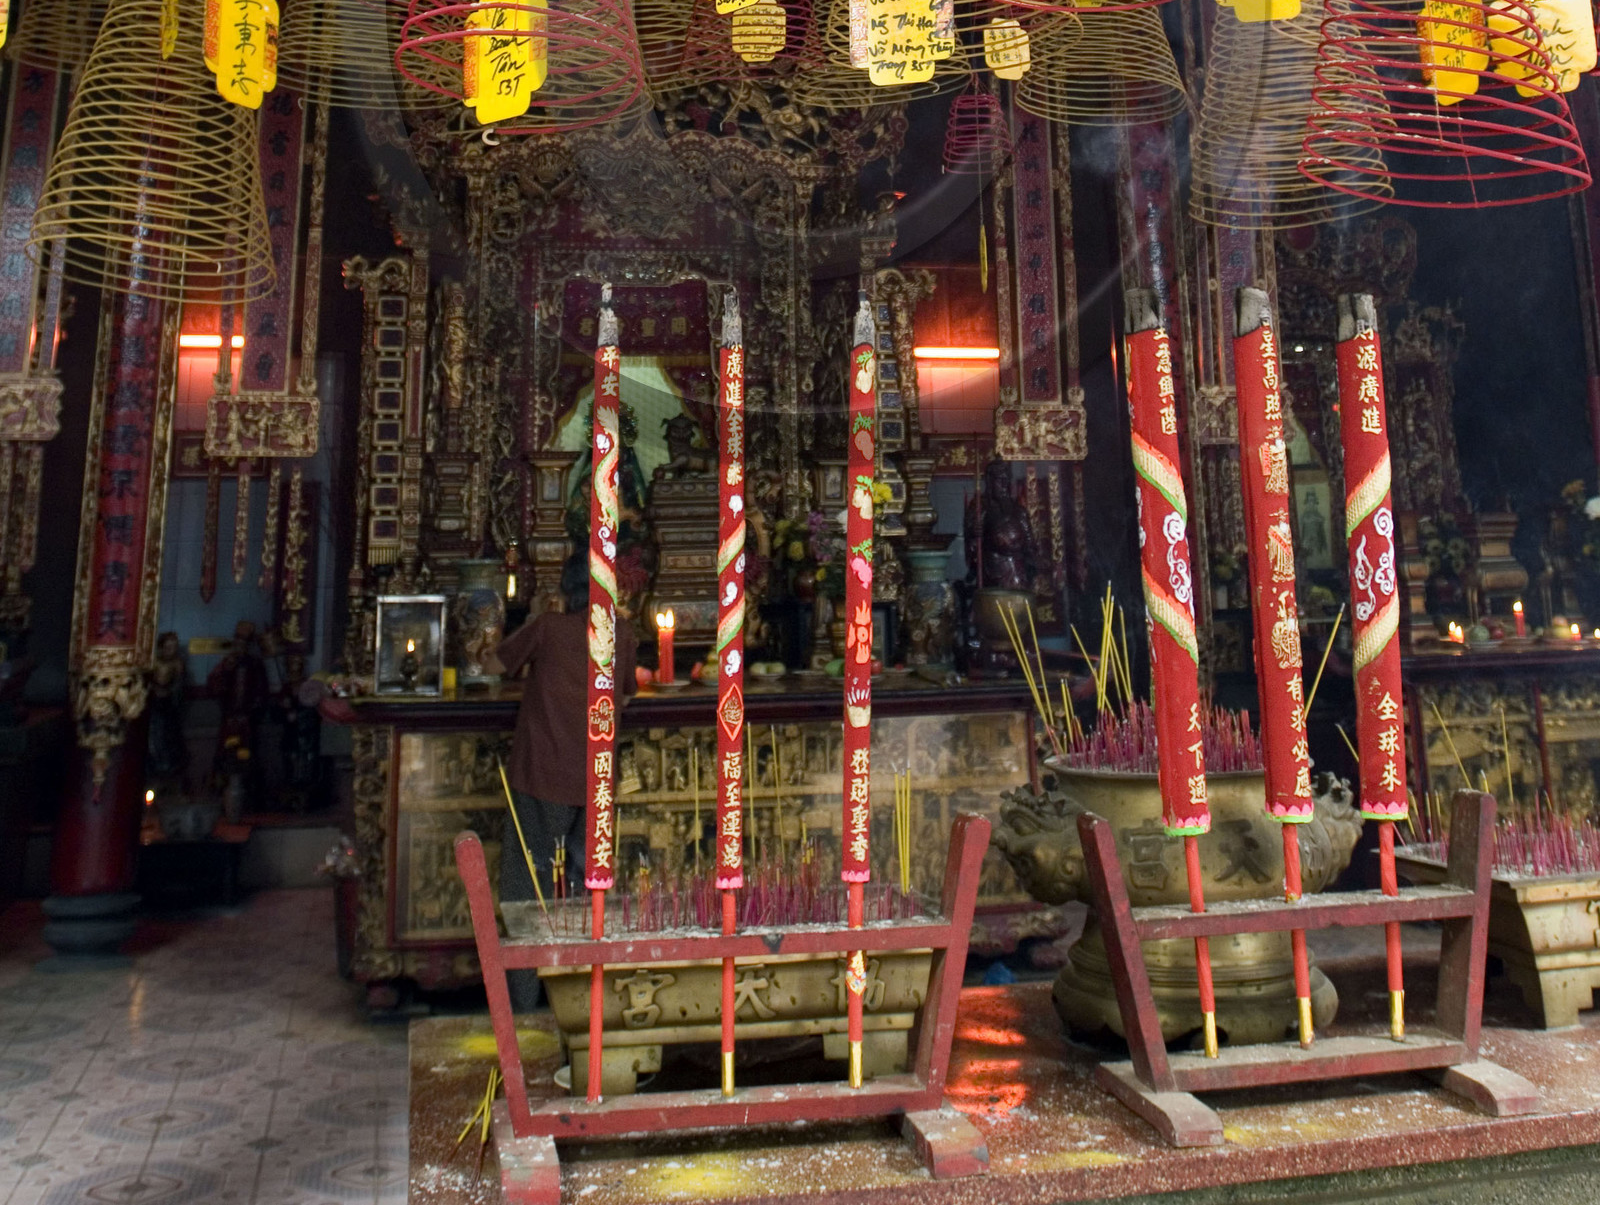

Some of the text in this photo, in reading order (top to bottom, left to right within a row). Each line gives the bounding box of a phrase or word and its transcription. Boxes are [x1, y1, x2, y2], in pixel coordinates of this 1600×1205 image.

[725, 345, 744, 487] 廣進全球來
[1257, 319, 1283, 422] 星高照
[1376, 691, 1403, 794] 全球來
[592, 750, 615, 869] 國泰民安
